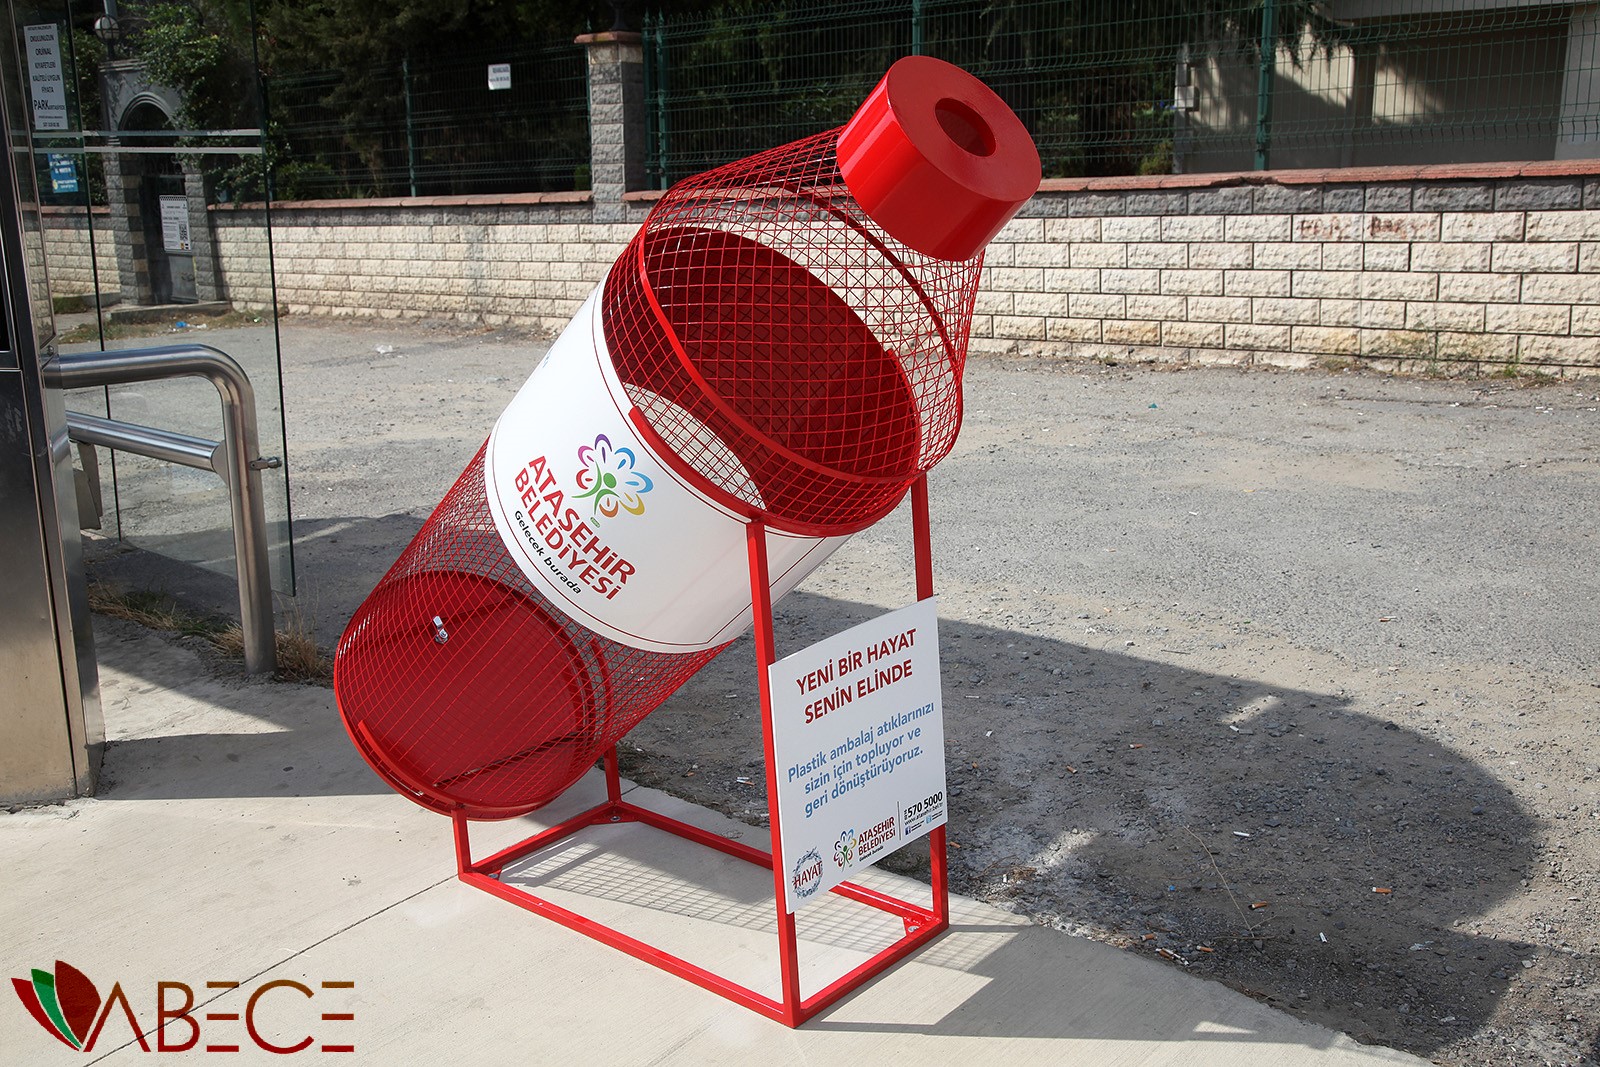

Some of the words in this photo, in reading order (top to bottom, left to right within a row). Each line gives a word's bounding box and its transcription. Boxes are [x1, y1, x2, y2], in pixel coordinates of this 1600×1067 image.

[33, 99, 49, 110] PARK
[514, 510, 545, 556] Gelecek
[544, 557, 582, 594] burada
[515, 467, 622, 600] BELEDİYESİ
[529, 455, 636, 584] ATAŞEHİR
[796, 658, 834, 696] YENİ
[838, 650, 863, 677] BİR
[866, 628, 917, 664] HAYAT
[804, 686, 853, 724] SENİN
[857, 659, 913, 699] ELİNDE
[787, 752, 827, 783] Plastik
[830, 727, 873, 761] ambalaj
[877, 702, 934, 737] atıklarınızı
[804, 772, 830, 794] sizin
[833, 760, 853, 780] için
[855, 734, 904, 770] topluyor
[907, 727, 921, 741] ve
[804, 790, 828, 818] geri
[831, 748, 923, 799] dönüştürüyoruz.
[907, 802, 922, 818] 570
[923, 791, 943, 810] 5000
[793, 860, 822, 889] HAYAT
[858, 827, 896, 856] BELEDİYESİ
